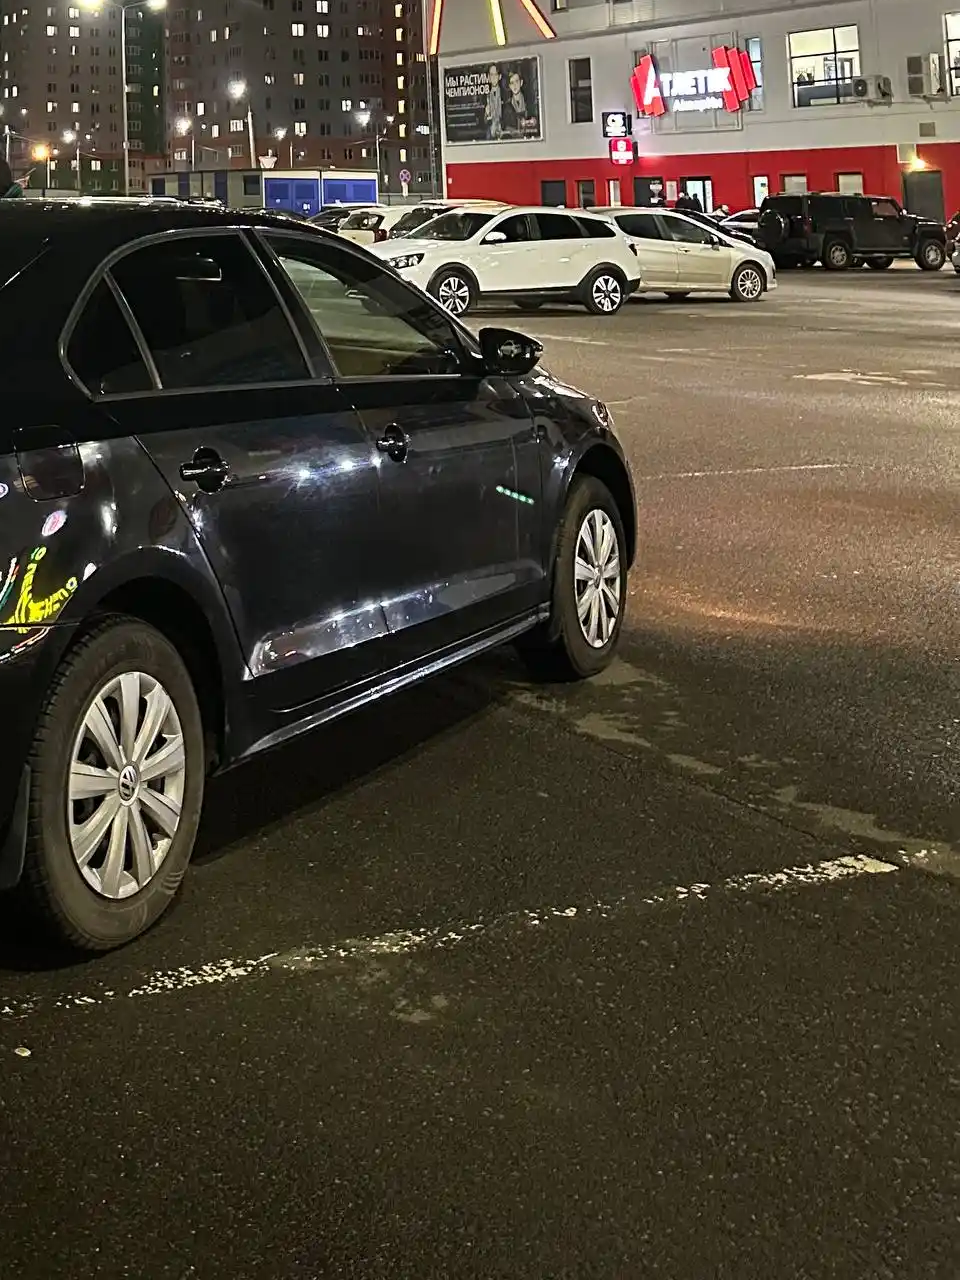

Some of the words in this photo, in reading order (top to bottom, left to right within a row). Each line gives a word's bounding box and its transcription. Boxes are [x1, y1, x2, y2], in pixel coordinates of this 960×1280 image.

[445, 75, 459, 87] МЫ
[460, 72, 489, 85] РАСТИМ
[445, 84, 489, 97] ЧЕМПИОНОВ
